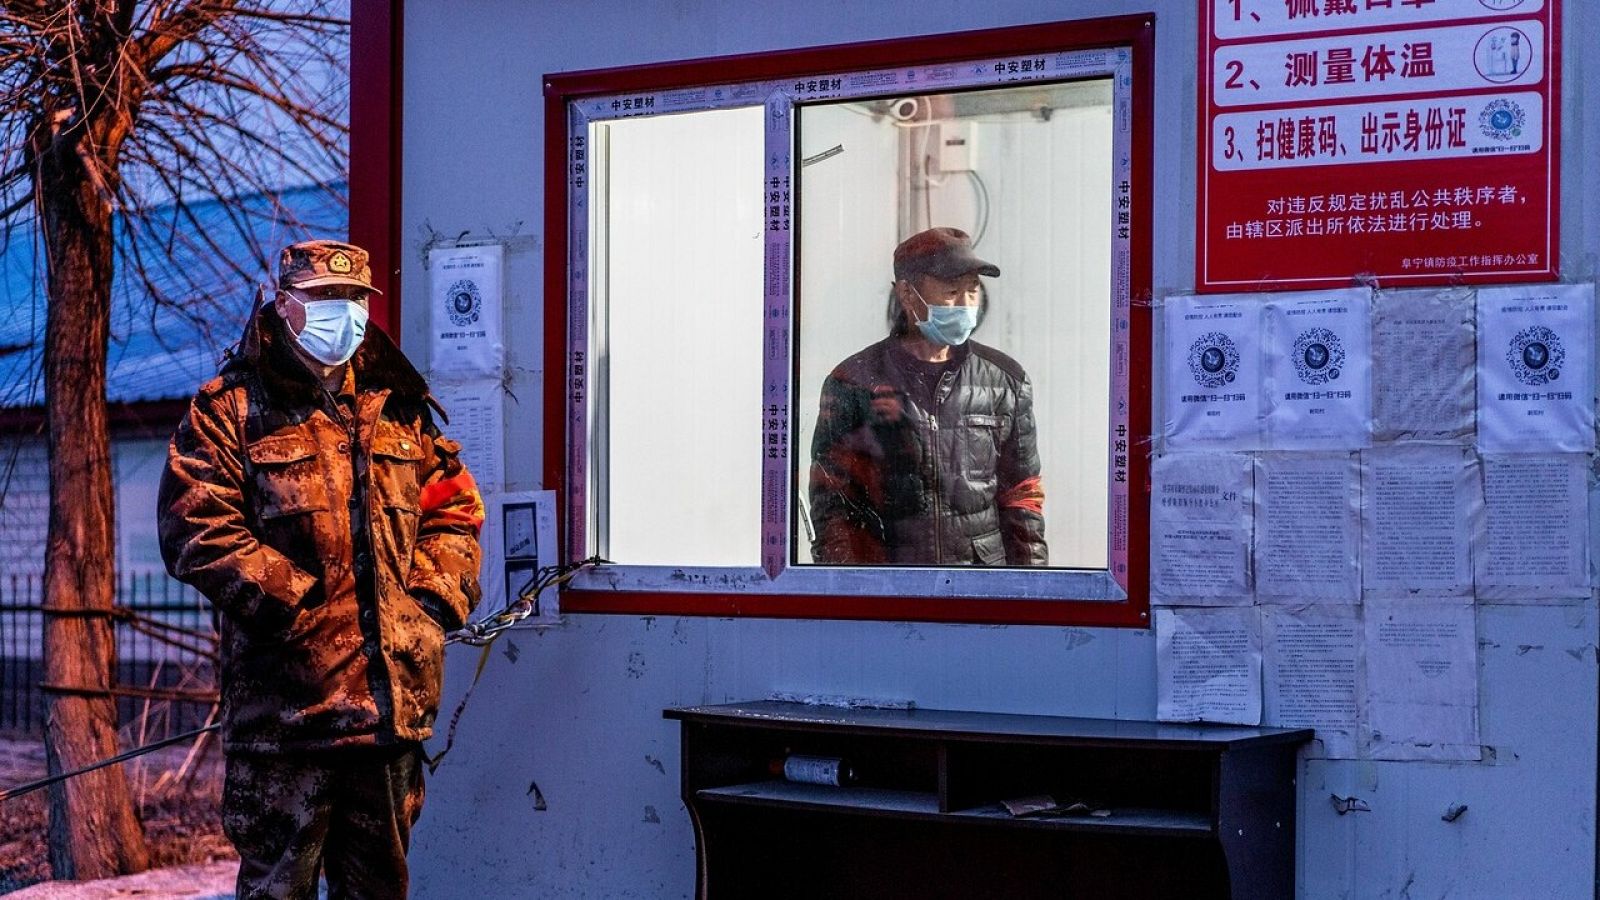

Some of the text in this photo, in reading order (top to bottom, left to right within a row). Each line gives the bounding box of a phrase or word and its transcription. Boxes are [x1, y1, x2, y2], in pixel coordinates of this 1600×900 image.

[1228, 0, 1436, 22] 1、佩
[794, 77, 843, 93] 中安塑材
[994, 57, 1046, 74] 中安塑材
[1225, 42, 1436, 90] 2、测量体温
[611, 95, 656, 111] 中安塑材
[1224, 107, 1467, 162] 3、扫健康码、出示身份证
[574, 135, 585, 188] 中安塑材
[769, 177, 781, 231] 中安塑材
[1118, 179, 1131, 241] 中安塑材
[1267, 185, 1527, 215] 对违反规定扰乱公共秩序者，
[1226, 211, 1484, 240] 由辖区派出所依法进行处理。
[574, 350, 585, 403] 中安塑材
[768, 404, 779, 459] 中安塑材
[1114, 423, 1127, 484] 中安塑材
